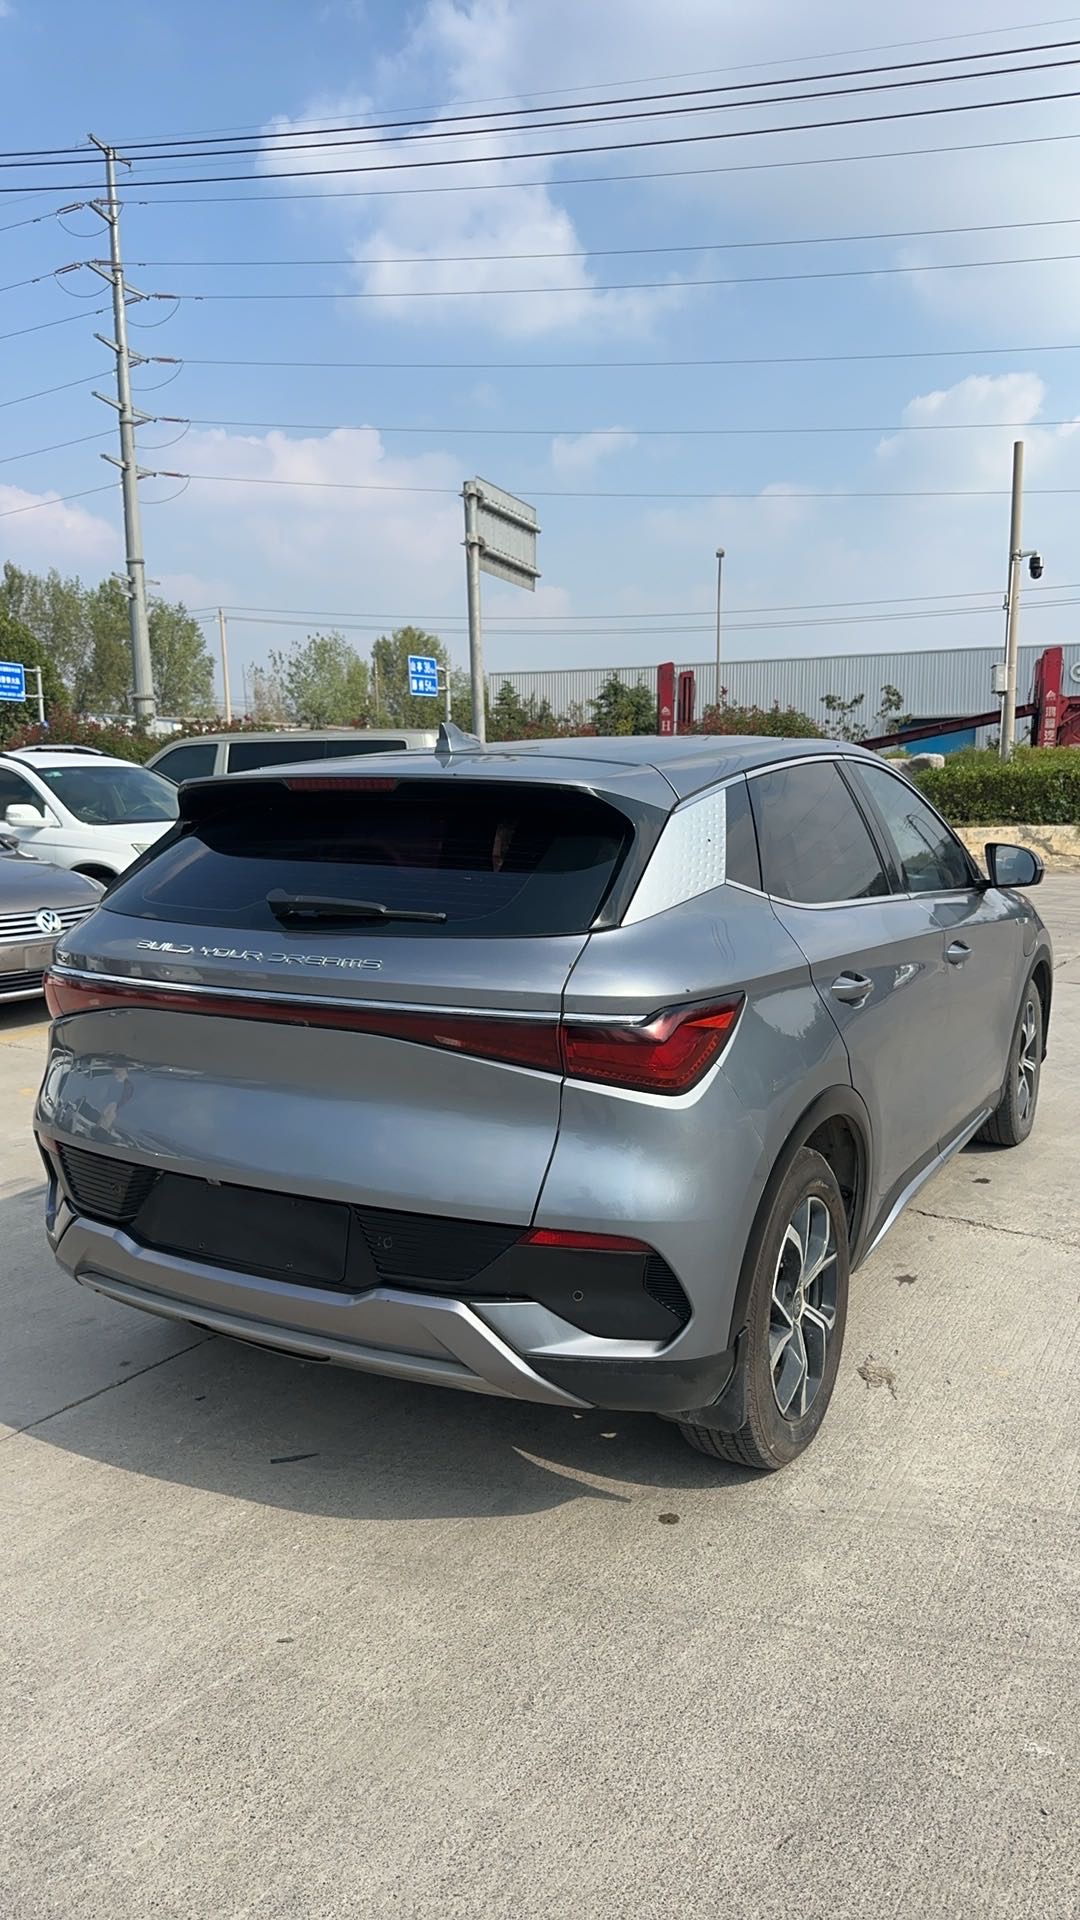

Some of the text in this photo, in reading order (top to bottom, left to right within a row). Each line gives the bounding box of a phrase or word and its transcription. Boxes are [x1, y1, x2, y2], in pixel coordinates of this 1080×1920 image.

[136, 939, 383, 971] BUILD YOUR DREAMS
